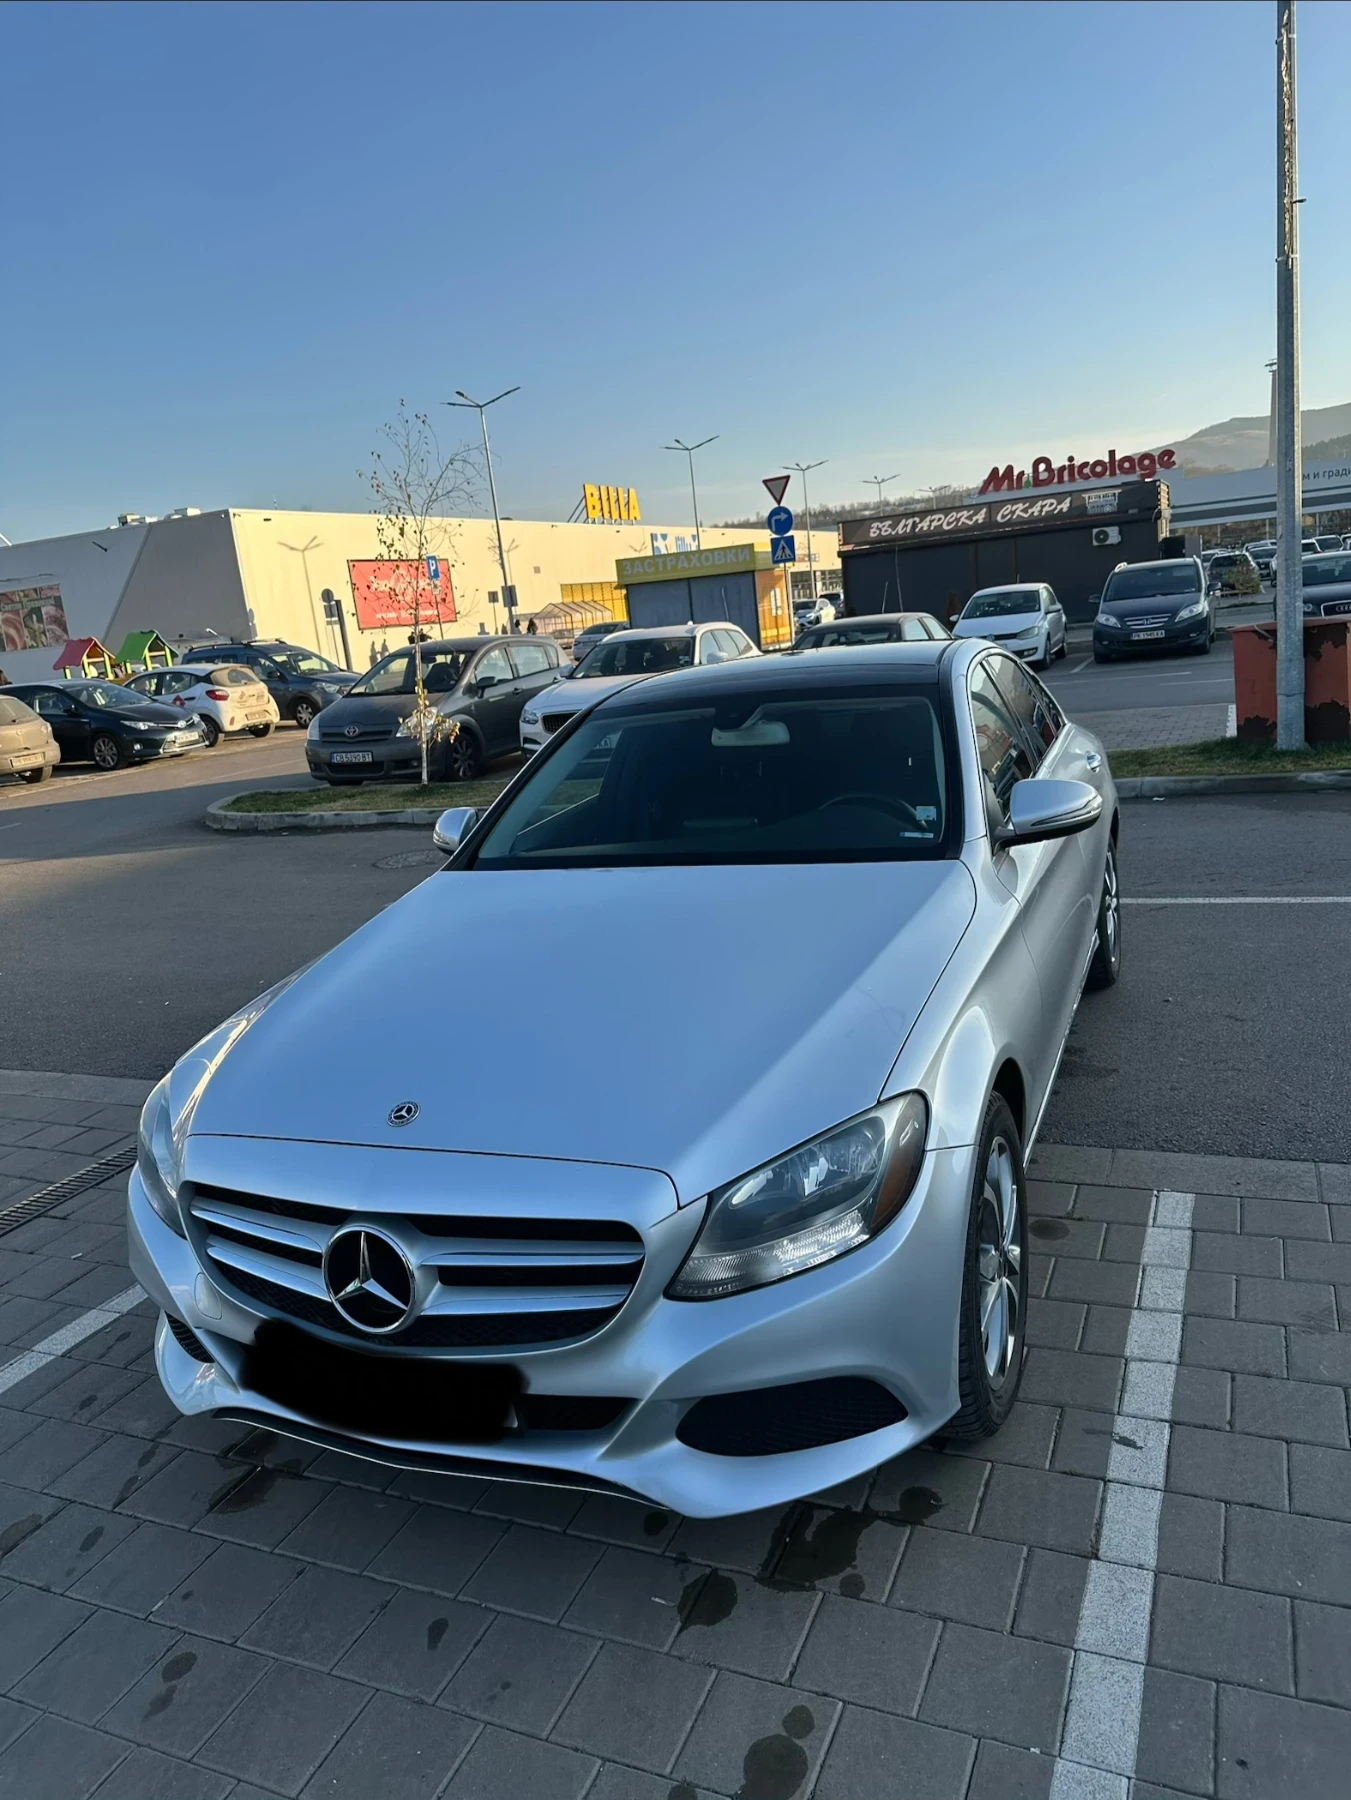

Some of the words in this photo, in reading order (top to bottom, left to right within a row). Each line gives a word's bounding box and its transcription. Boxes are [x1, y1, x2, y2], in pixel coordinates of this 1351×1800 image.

[1032, 449, 1177, 488] Bricolage
[583, 483, 642, 521] BILLA
[869, 507, 989, 537] БЪЛГАРСКА
[996, 497, 1073, 523] СКАРА
[622, 548, 751, 576] ЗАСТРАХОВКИ
